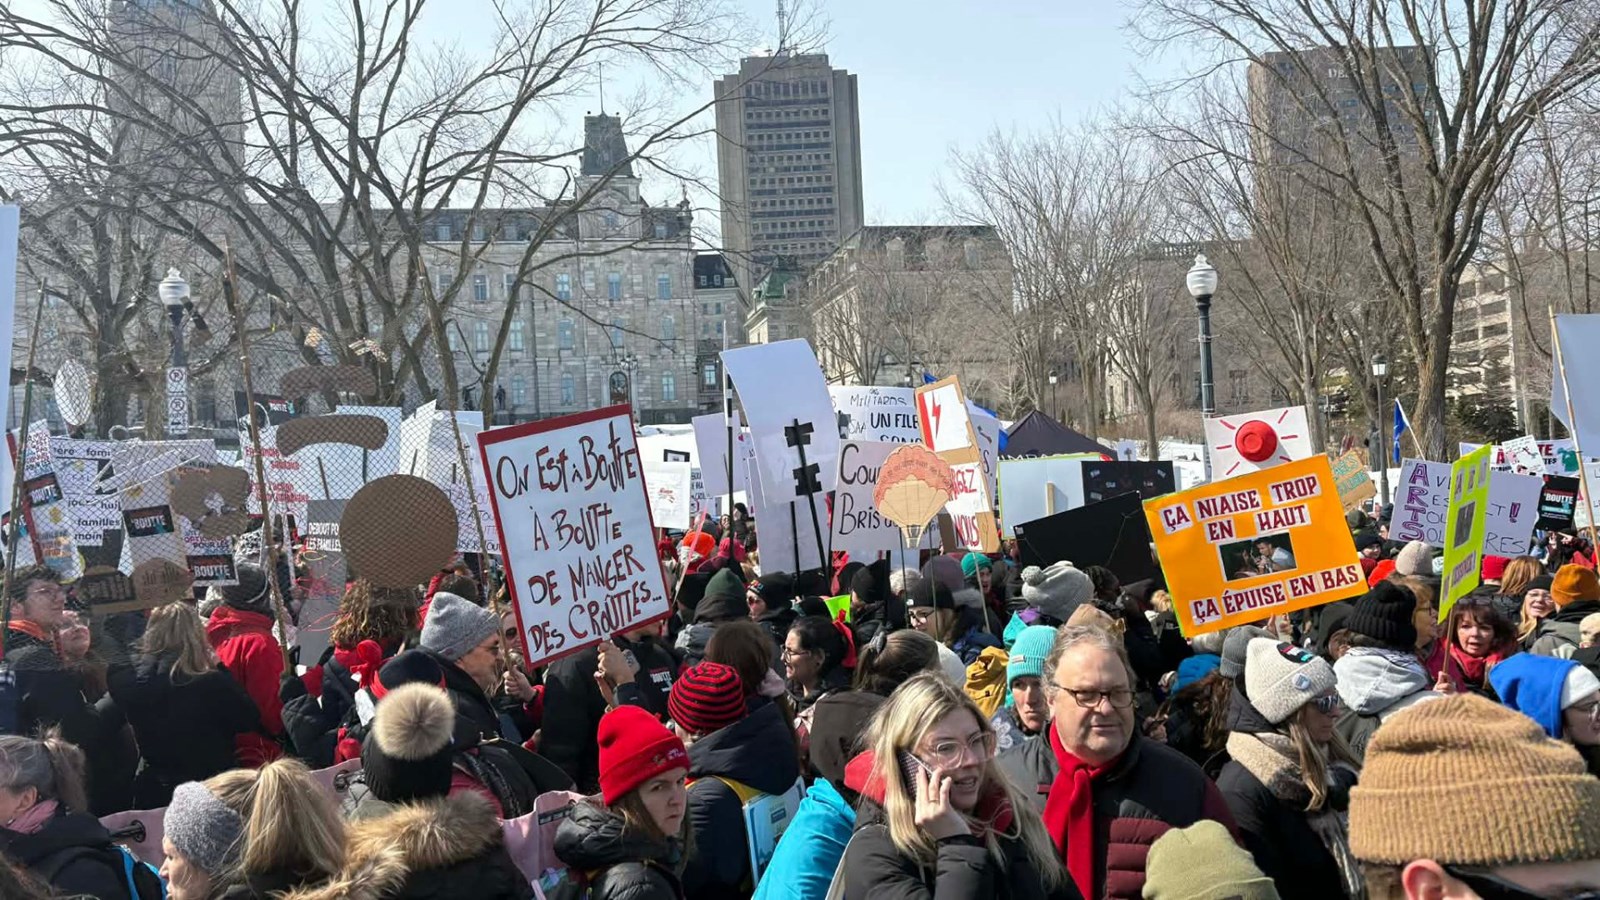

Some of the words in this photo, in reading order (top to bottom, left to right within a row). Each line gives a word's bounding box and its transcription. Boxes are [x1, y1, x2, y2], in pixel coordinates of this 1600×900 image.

[870, 412, 890, 429] UN
[496, 455, 529, 499] ON
[535, 445, 568, 493] EST
[1163, 505, 1190, 531] ÇA
[1197, 490, 1260, 519] NIAISE
[1271, 476, 1318, 502] TROP
[1208, 519, 1234, 542] EN
[1257, 505, 1306, 531] HAUT
[528, 570, 562, 606] DE
[567, 544, 646, 602] MANGER
[1193, 598, 1220, 623] ÇA
[1222, 583, 1286, 614] ÉPUISE
[1289, 575, 1316, 597] EN
[1320, 565, 1359, 590] BAS
[528, 620, 566, 655] DES
